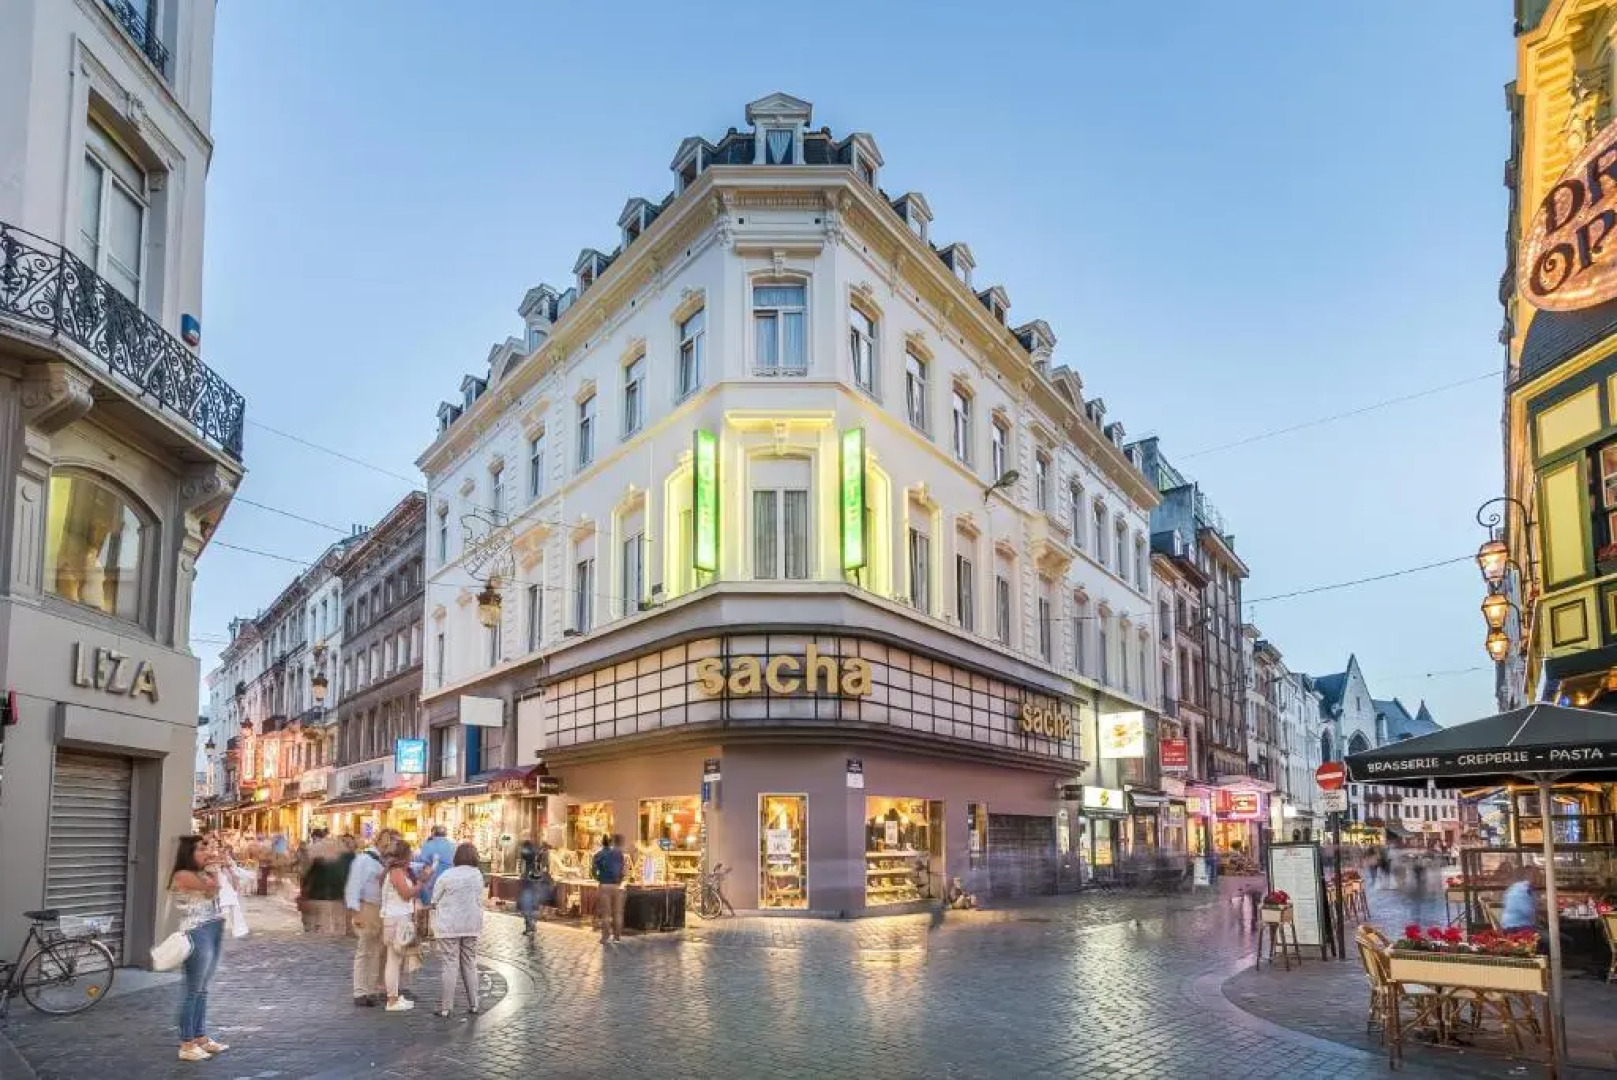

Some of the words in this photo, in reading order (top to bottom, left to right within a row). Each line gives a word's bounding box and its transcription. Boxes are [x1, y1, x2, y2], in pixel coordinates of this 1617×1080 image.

[695, 643, 872, 696] sacha
[1022, 700, 1073, 741] sacha
[1367, 757, 1440, 773] BRASSERIE
[1458, 751, 1529, 767] CREPERIE
[1550, 748, 1603, 761] PASTA
